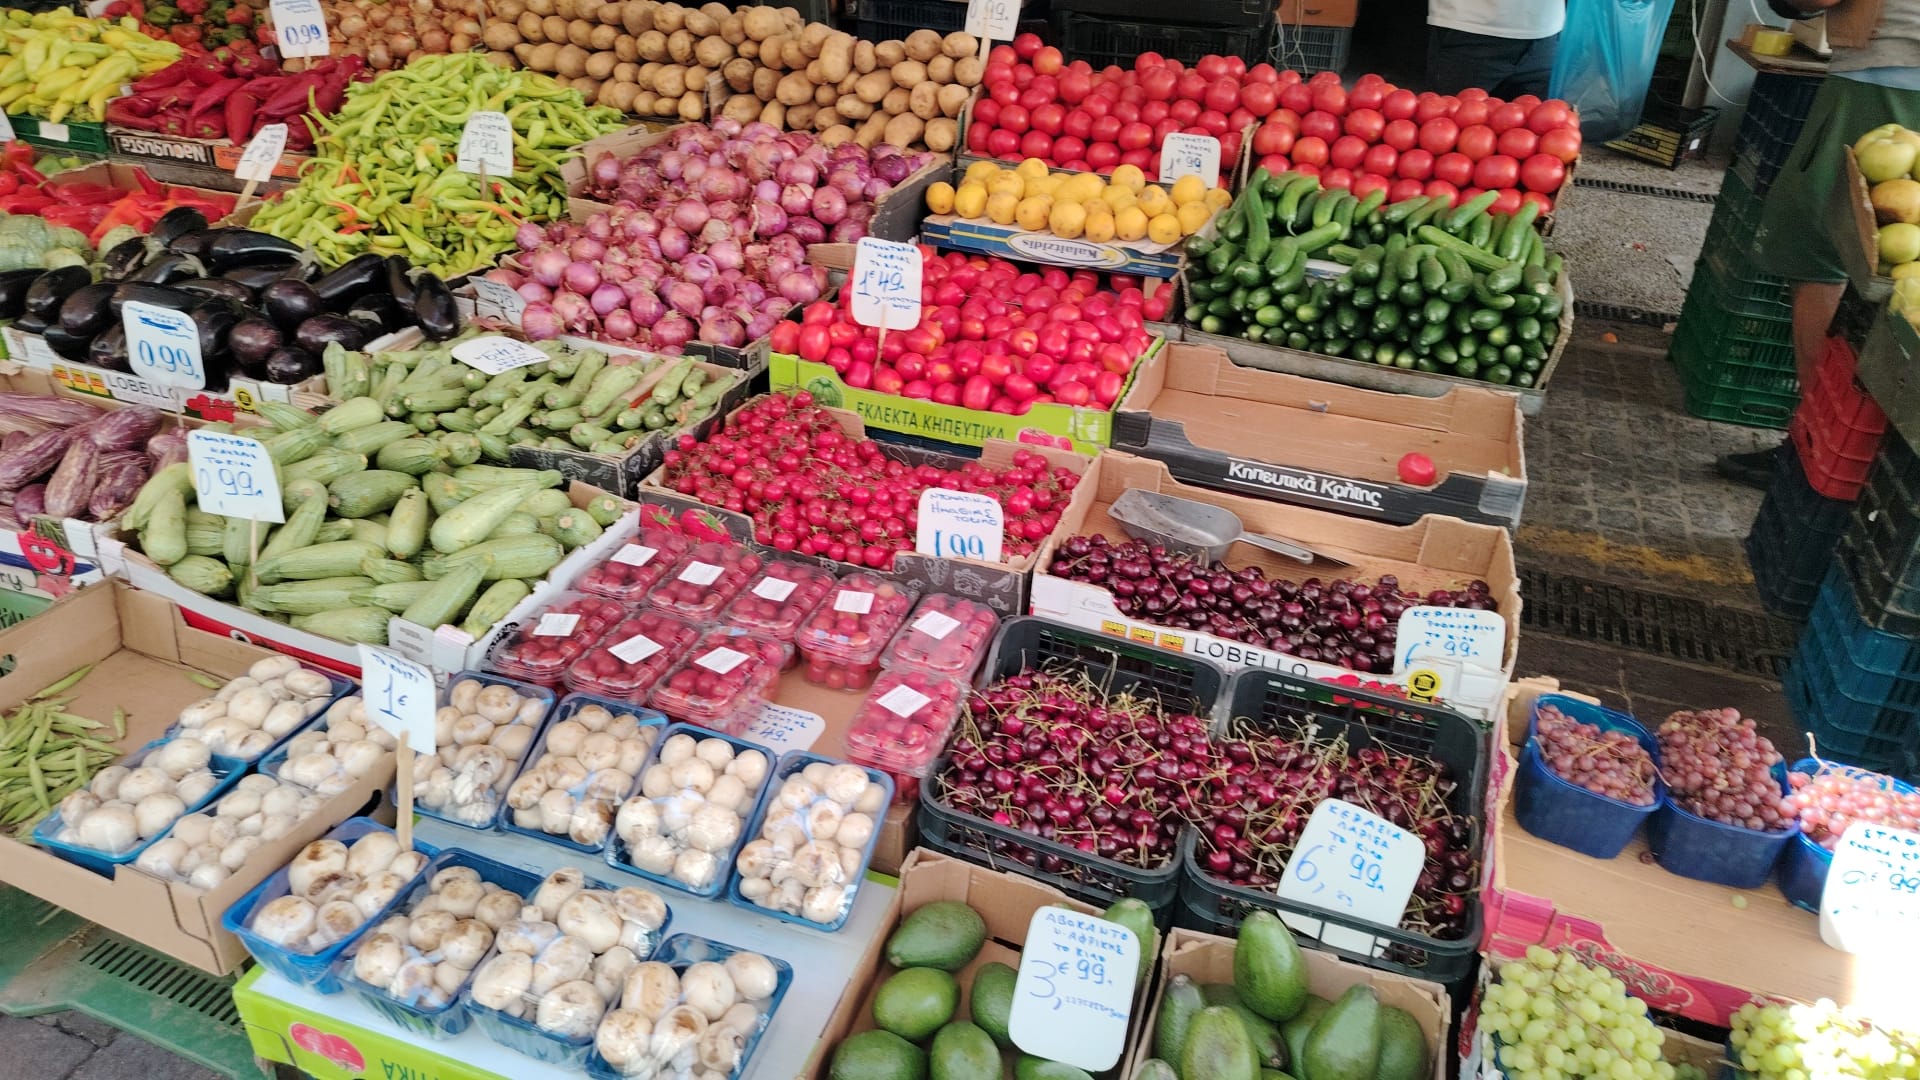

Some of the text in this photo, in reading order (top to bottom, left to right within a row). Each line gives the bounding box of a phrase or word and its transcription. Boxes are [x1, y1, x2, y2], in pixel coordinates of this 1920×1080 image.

[1021, 239, 1098, 259] Kalaitzidis
[106, 376, 178, 400] LOBELLO
[857, 401, 1004, 439] ΕΚΛΕΚΤΑ ΚΗΠΕΥΤΙΚΑ
[1193, 638, 1308, 677] LOBELLO
[1328, 804, 1402, 841] ΚΕΡΑΣΙΑ
[1864, 829, 1920, 846] ΣΤΑΦ
[1045, 913, 1129, 940] ΑΒΟΚΑΝΤΟ
